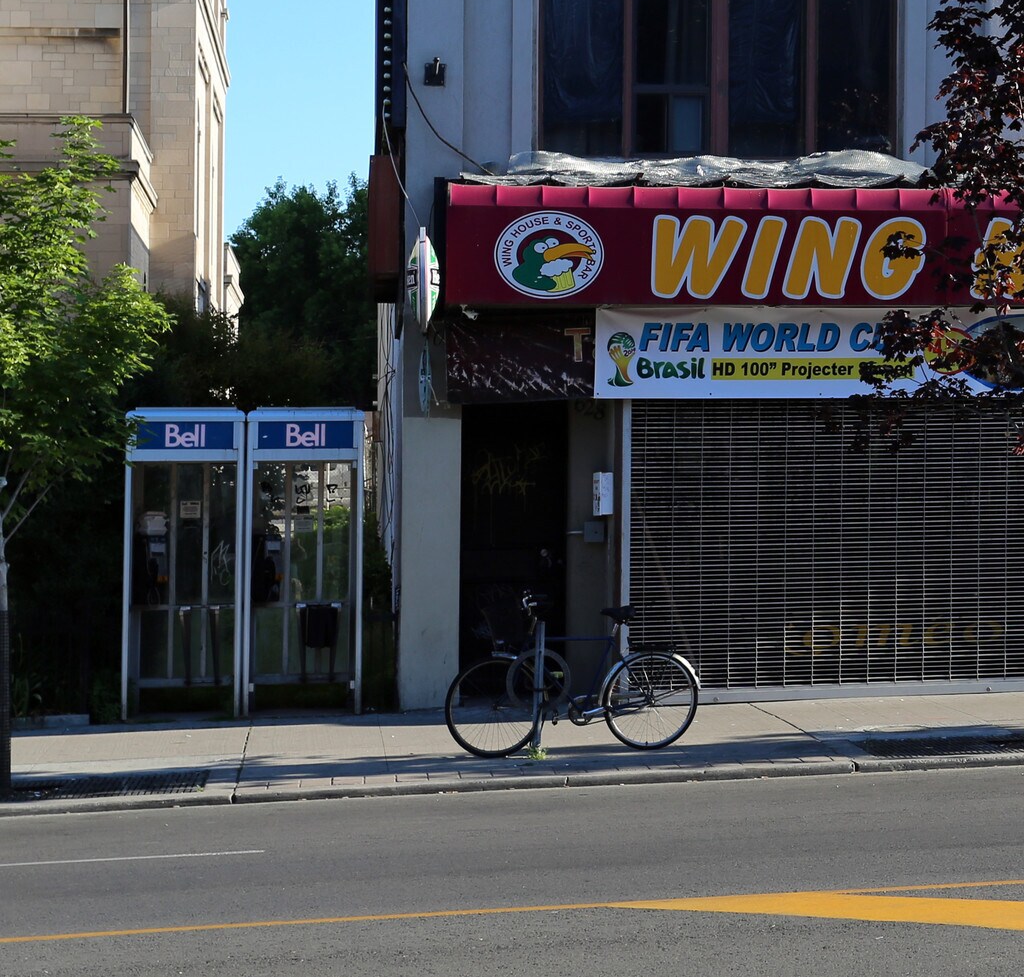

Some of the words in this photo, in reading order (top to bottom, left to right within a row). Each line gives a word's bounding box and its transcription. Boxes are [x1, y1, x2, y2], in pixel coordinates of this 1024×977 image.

[501, 239, 514, 267] WING
[510, 216, 550, 239] HOUSE
[553, 217, 562, 226] &
[577, 258, 596, 280] BAR
[651, 214, 927, 300] WING
[638, 322, 710, 352] FIFA
[722, 322, 841, 352] WORLD
[636, 357, 706, 380] Brasil
[712, 361, 736, 376] HD
[781, 361, 854, 379] Projecter
[164, 424, 205, 448] Bell
[285, 423, 326, 447] Bell
